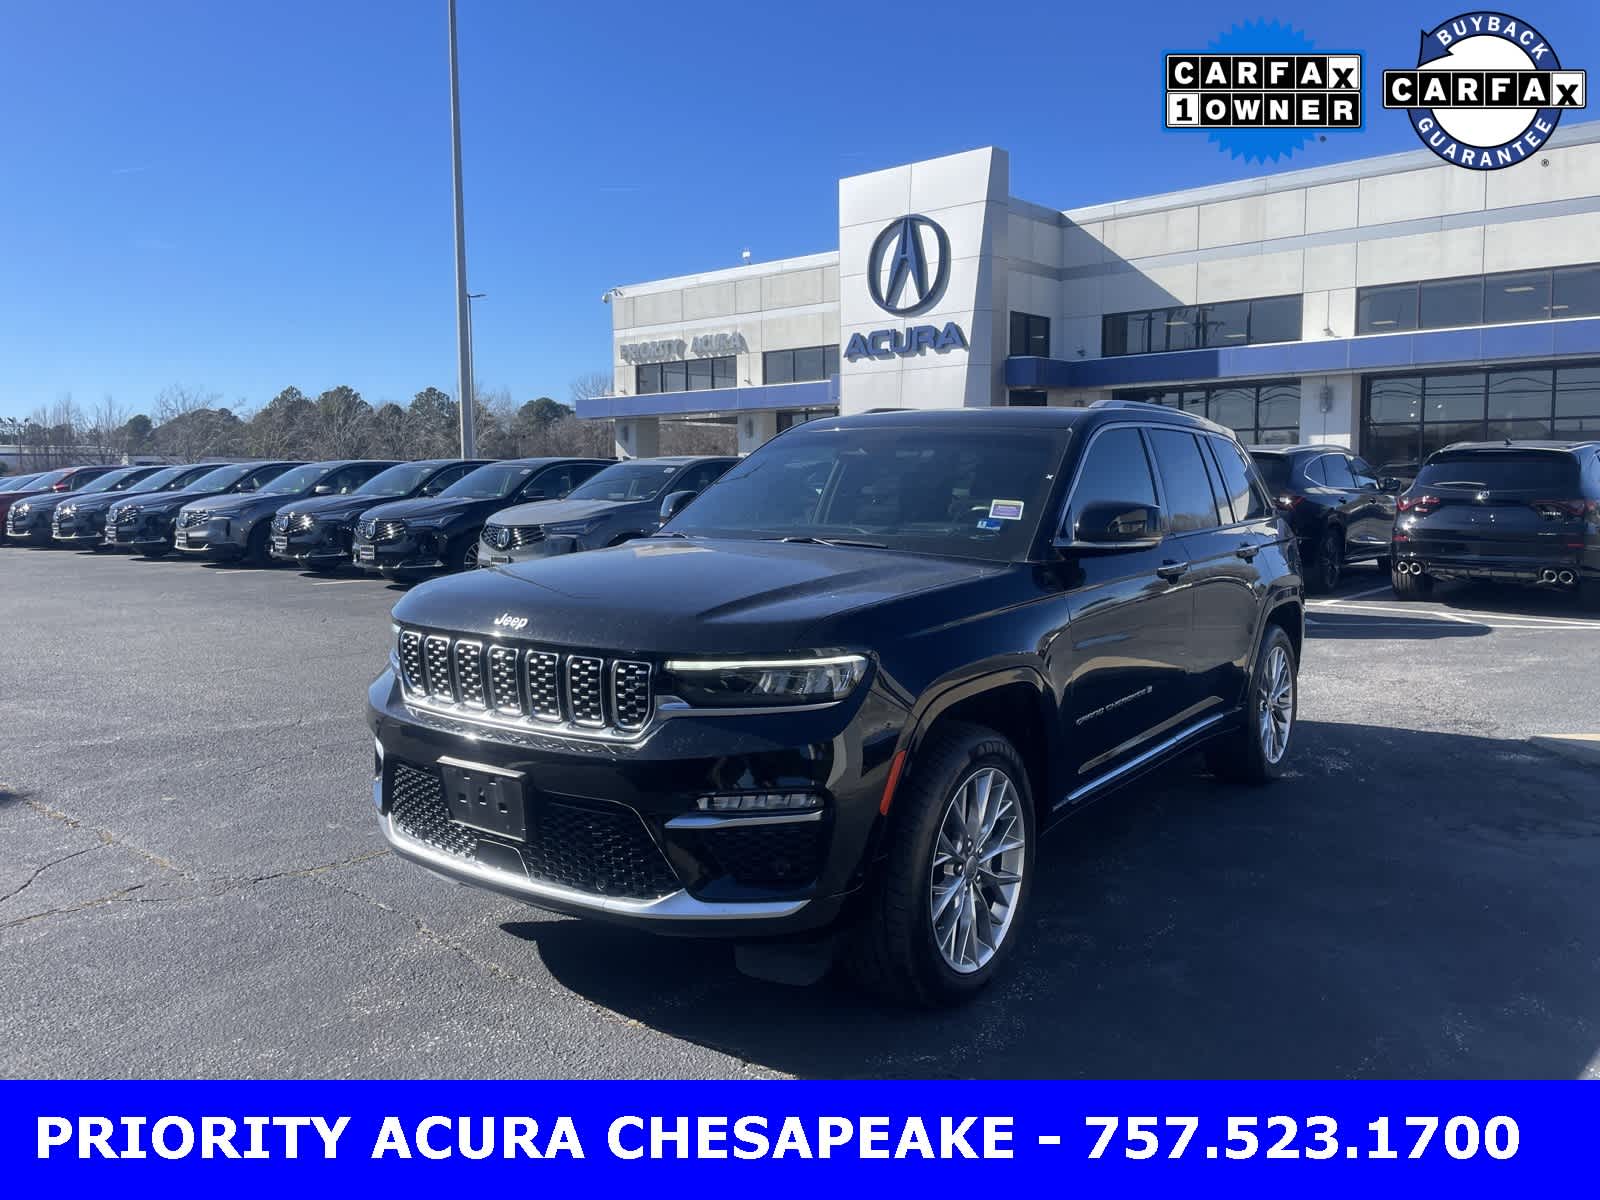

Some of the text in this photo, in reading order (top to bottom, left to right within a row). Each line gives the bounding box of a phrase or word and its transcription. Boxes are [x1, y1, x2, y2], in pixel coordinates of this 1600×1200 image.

[690, 330, 749, 358] ACURA
[844, 321, 969, 361] ACURA
[494, 613, 528, 630] Jeep
